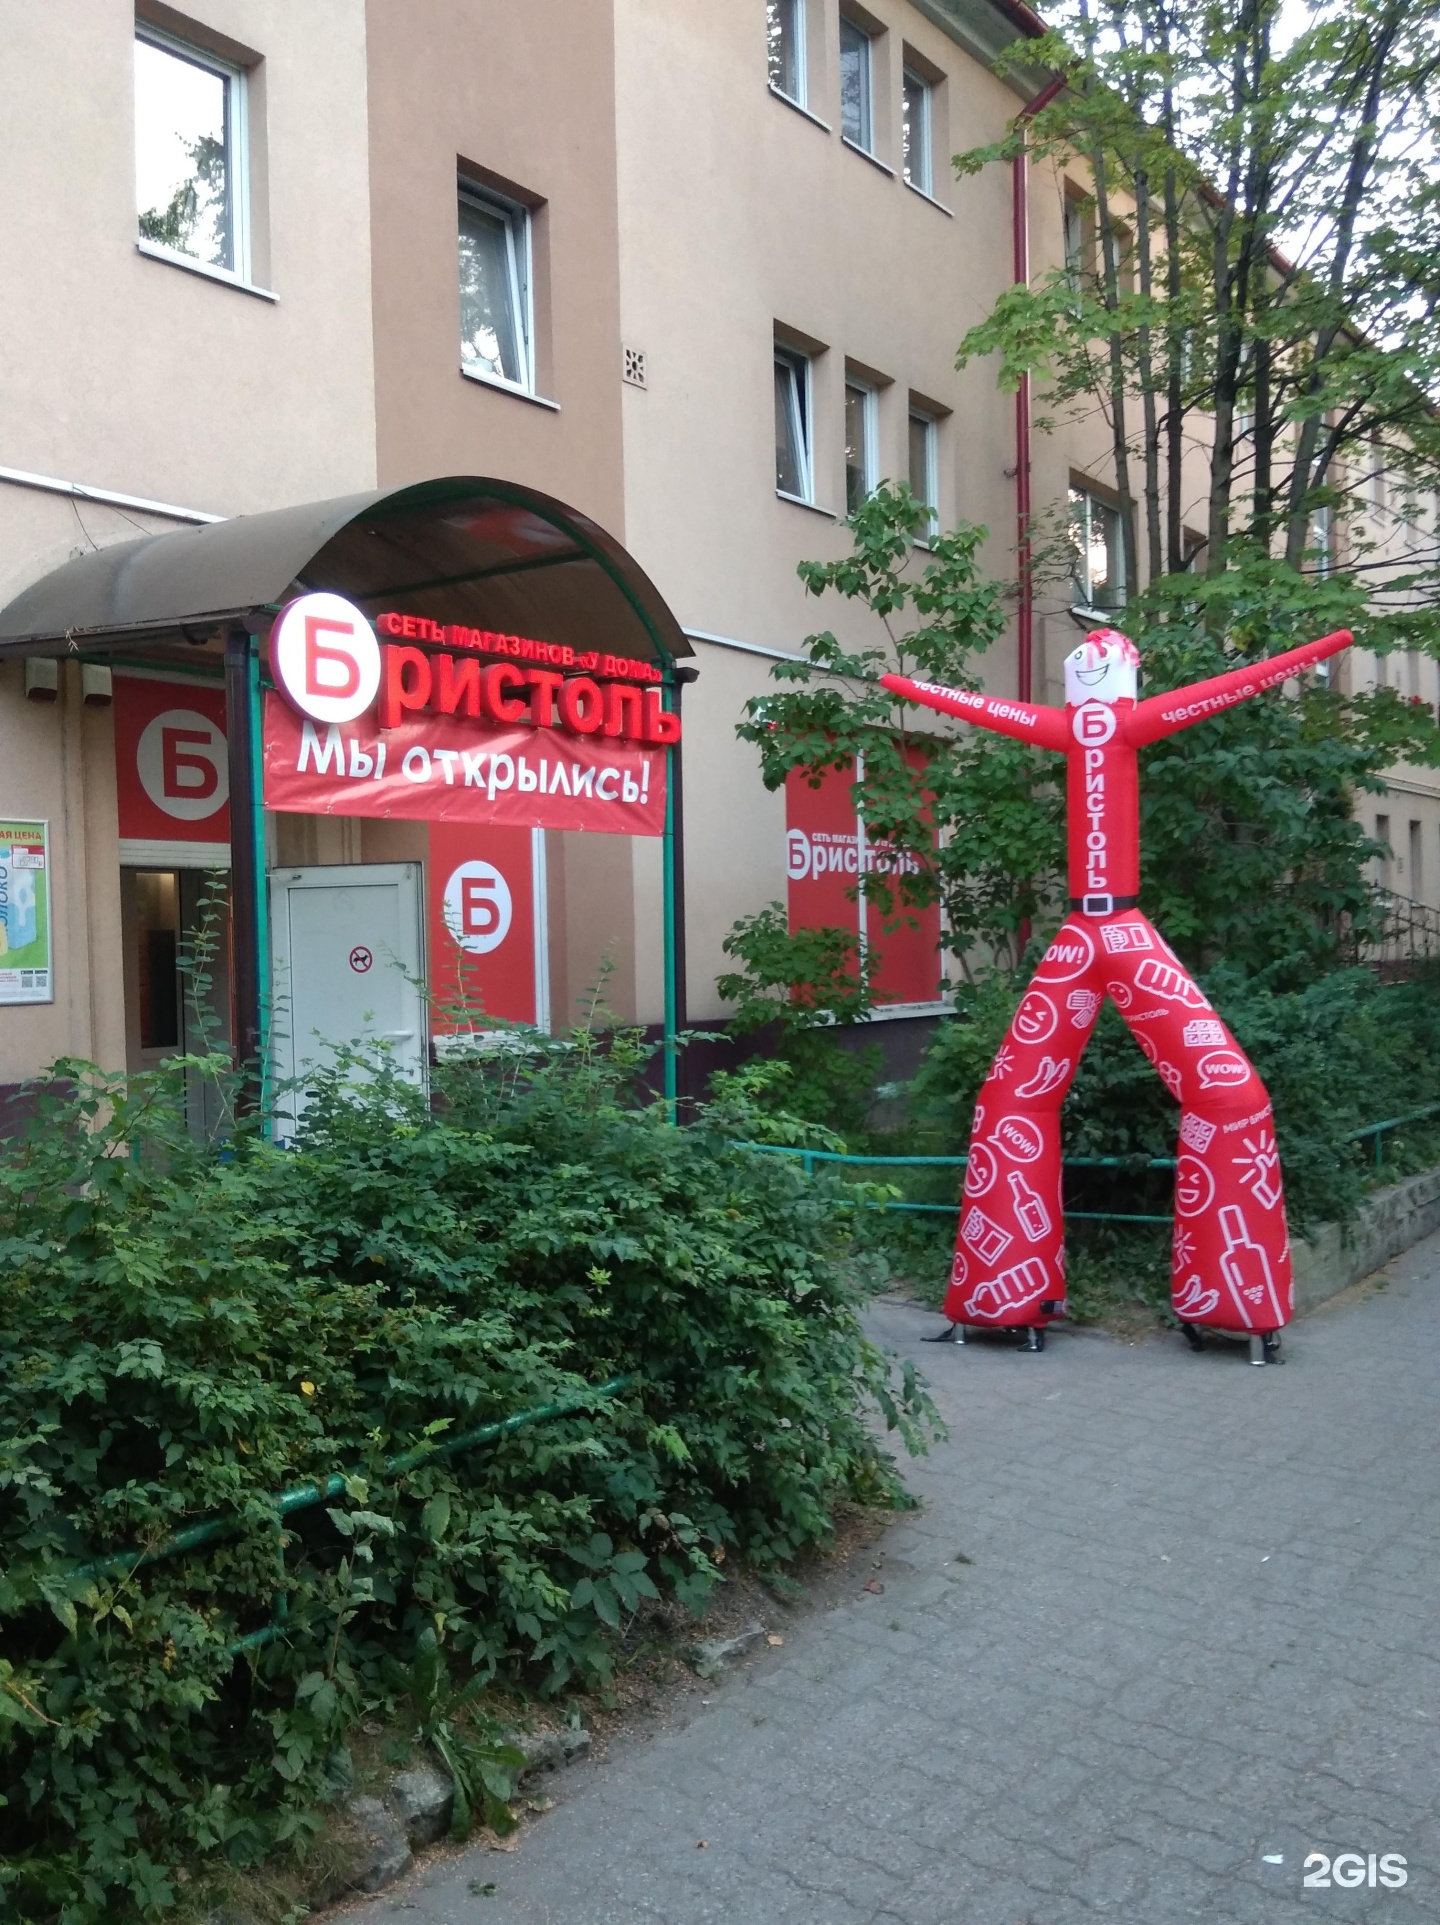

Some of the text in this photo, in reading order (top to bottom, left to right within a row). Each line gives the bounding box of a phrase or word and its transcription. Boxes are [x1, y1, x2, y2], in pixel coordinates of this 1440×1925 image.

[378, 613, 444, 642] СЕТЬ
[443, 625, 575, 667] МАГАЗИНОВ
[303, 612, 682, 743] Бристоль
[912, 680, 1037, 727] честные цены
[1161, 684, 1256, 724] честные
[162, 727, 218, 799] Б
[297, 721, 650, 804] Мы открылись!
[1079, 707, 1110, 889] Бристоль
[14, 831, 42, 840] ЦЕНА
[812, 833, 832, 843] СЕТЬ
[462, 877, 501, 936] Б
[1041, 944, 1085, 965] OW!
[1002, 1123, 1038, 1157] WOW!
